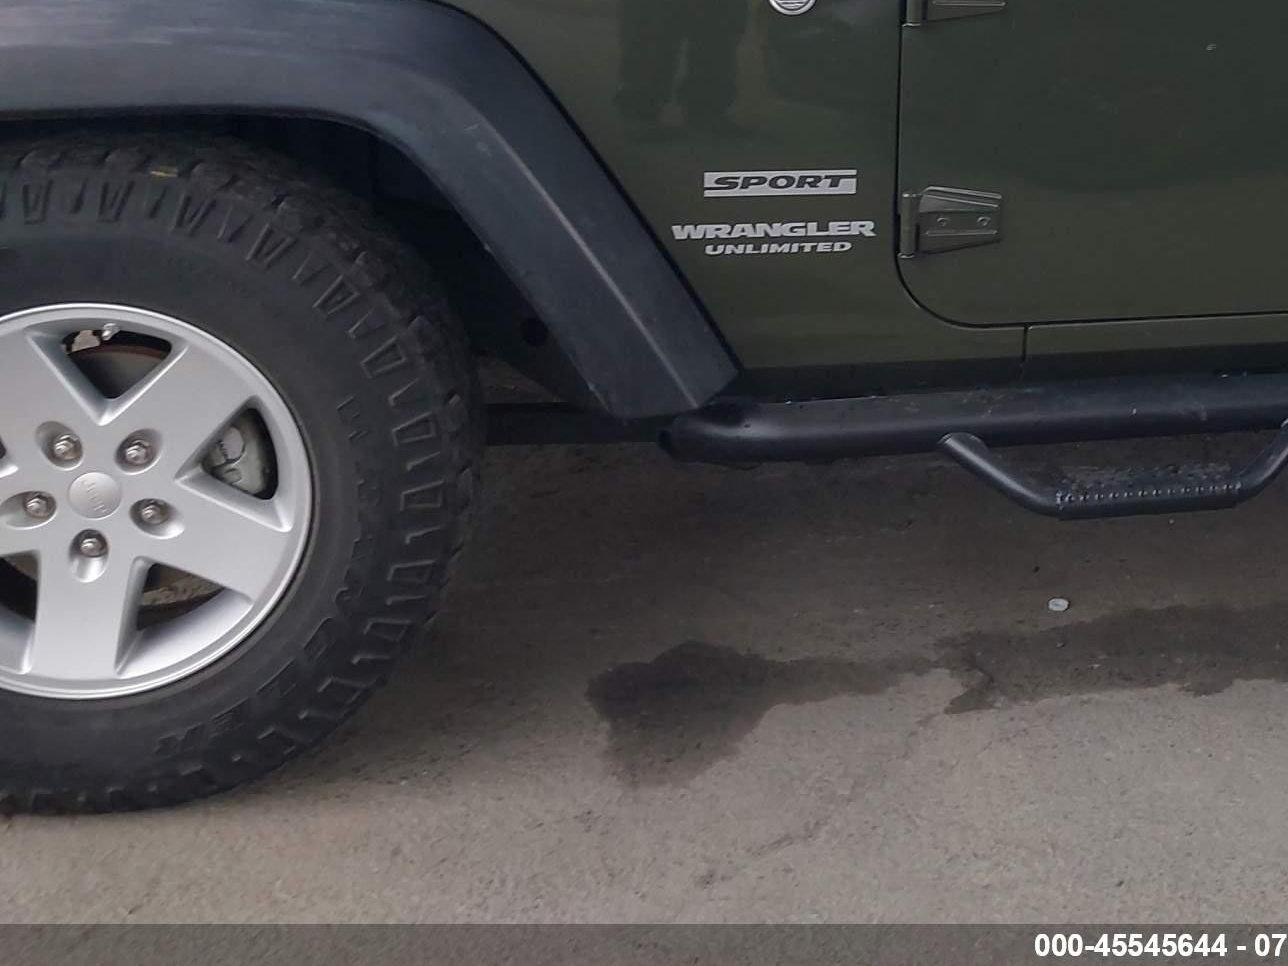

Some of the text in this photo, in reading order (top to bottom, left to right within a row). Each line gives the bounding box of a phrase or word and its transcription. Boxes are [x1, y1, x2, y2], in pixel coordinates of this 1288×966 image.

[713, 174, 845, 190] SPORT
[672, 221, 876, 238] WRANGLER
[704, 242, 852, 255] UNLIMITED
